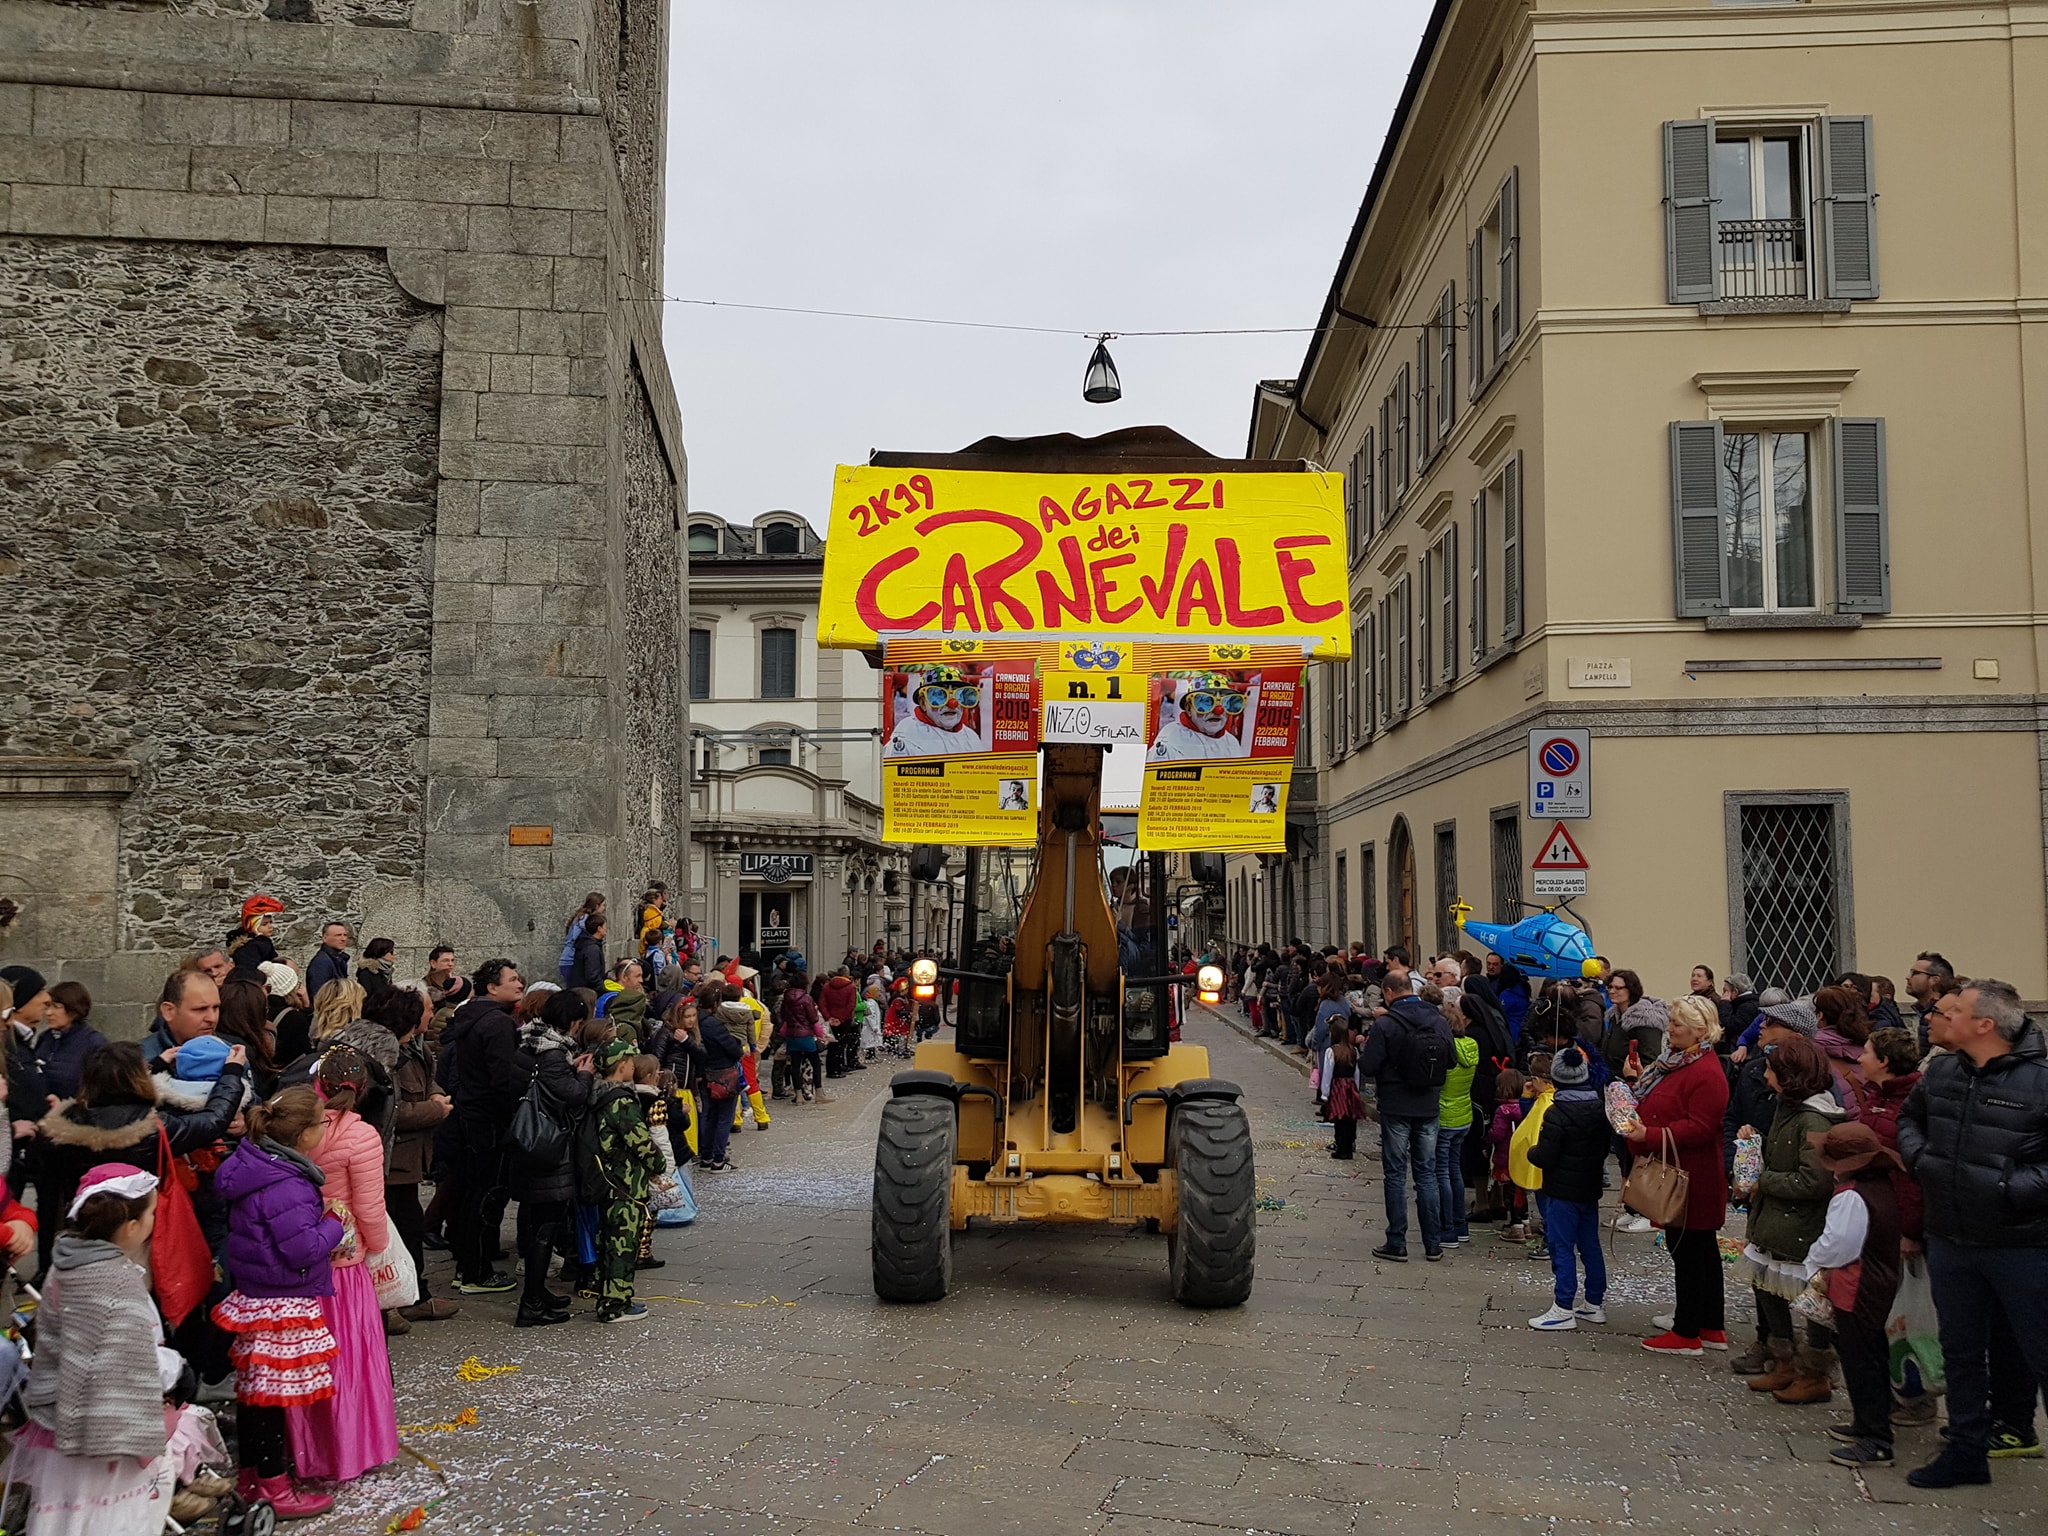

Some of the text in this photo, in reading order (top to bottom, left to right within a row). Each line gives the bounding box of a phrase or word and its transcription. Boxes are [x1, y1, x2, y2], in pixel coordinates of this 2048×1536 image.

[848, 474, 935, 537] 2K19
[1087, 525, 1140, 552] dei
[855, 508, 1344, 634] CARNEVALE
[1586, 662, 1614, 670] PIAZZA
[995, 673, 1031, 683] CARNEVALE
[1584, 673, 1618, 681] CAMPELLO
[1004, 683, 1030, 692] RAGAZZI
[1067, 676, 1122, 699] n. 1
[1262, 681, 1296, 691] CARNEVALE
[1003, 692, 1030, 700] SONDRIO
[1270, 691, 1294, 700] RAGAZZI
[995, 700, 1030, 720] 2019
[1258, 707, 1292, 727] 2019
[995, 720, 1029, 730] 22/23/24
[995, 730, 1029, 741] FEBBRAIO
[1090, 724, 1140, 739] SFILATA
[1256, 727, 1289, 736] 22/23/24
[1254, 736, 1288, 747] FEBBRAIO
[900, 766, 940, 776] PROGRAMMA
[1160, 771, 1197, 780] PROGRAMMA
[1541, 783, 1552, 797] P
[745, 855, 809, 871] LIBERTY
[761, 930, 788, 938] GELATO
